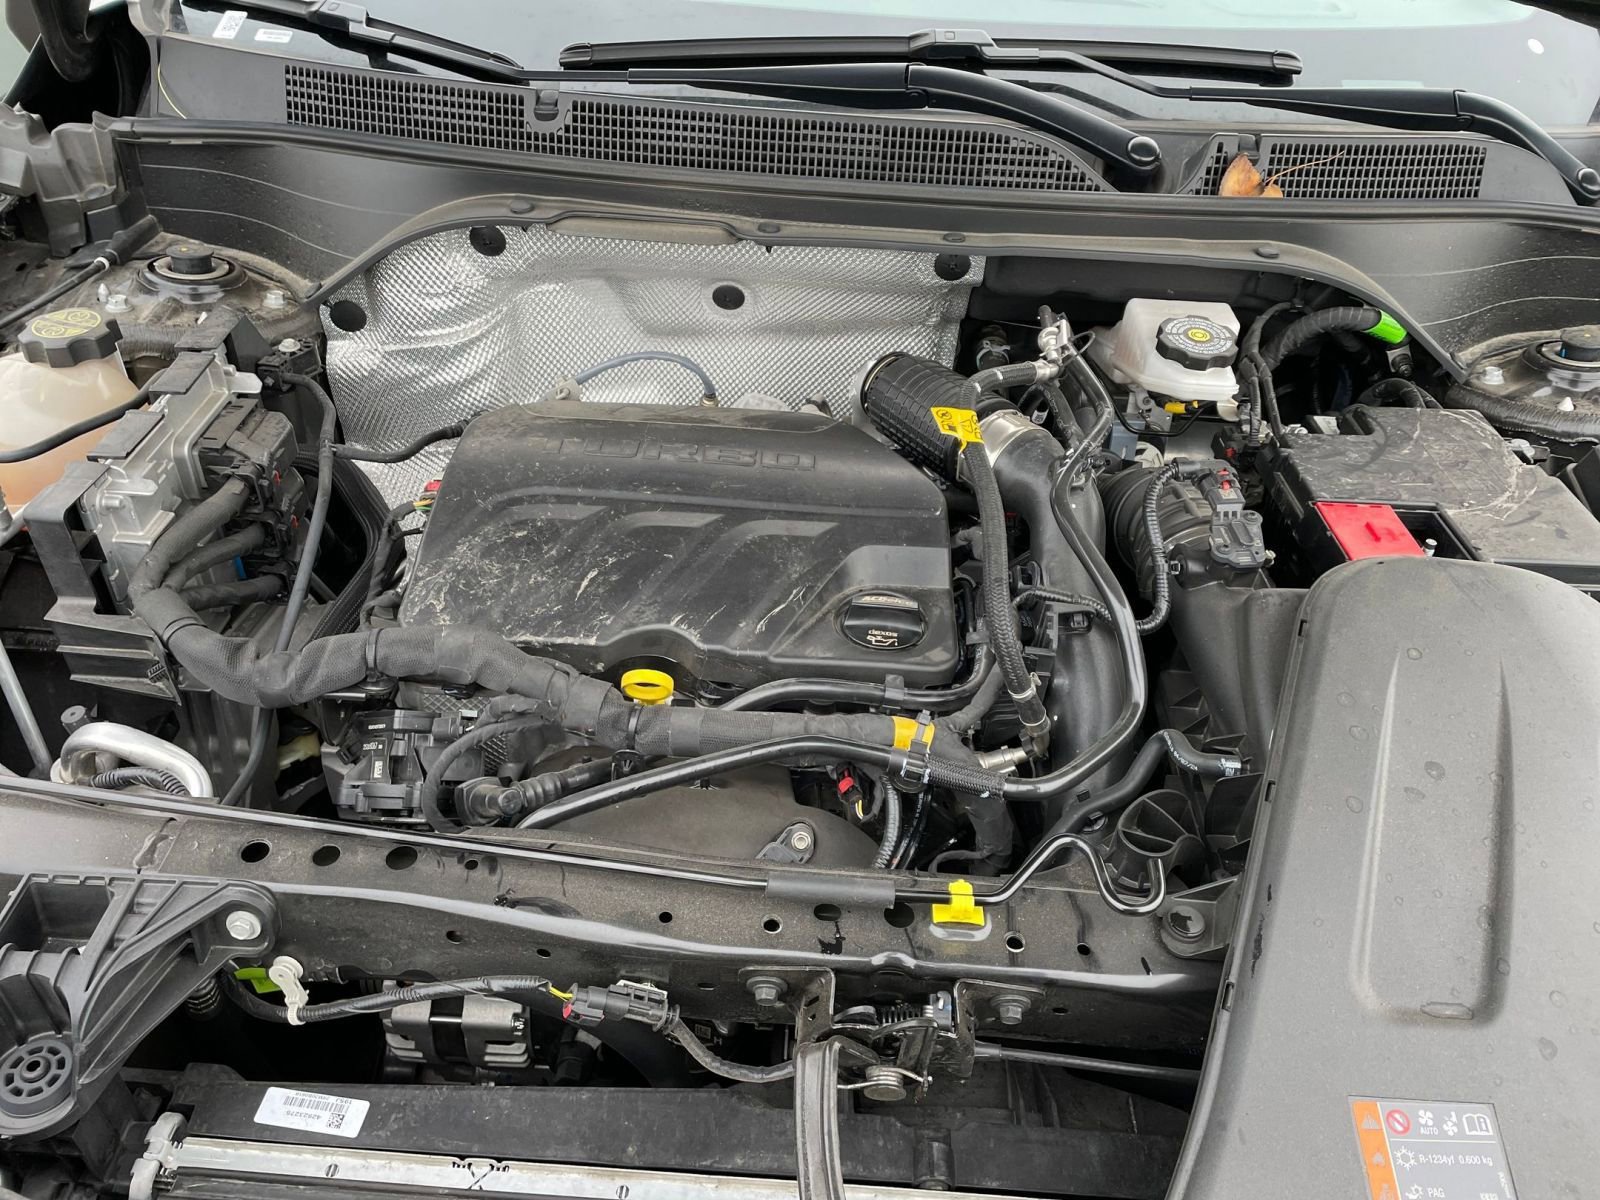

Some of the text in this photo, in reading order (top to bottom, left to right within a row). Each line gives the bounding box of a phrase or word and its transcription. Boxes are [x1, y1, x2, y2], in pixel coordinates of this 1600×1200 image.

[1420, 1127, 1438, 1135] AUTO
[1481, 1155, 1493, 1167] kg
[1427, 1187, 1446, 1198] PAG
